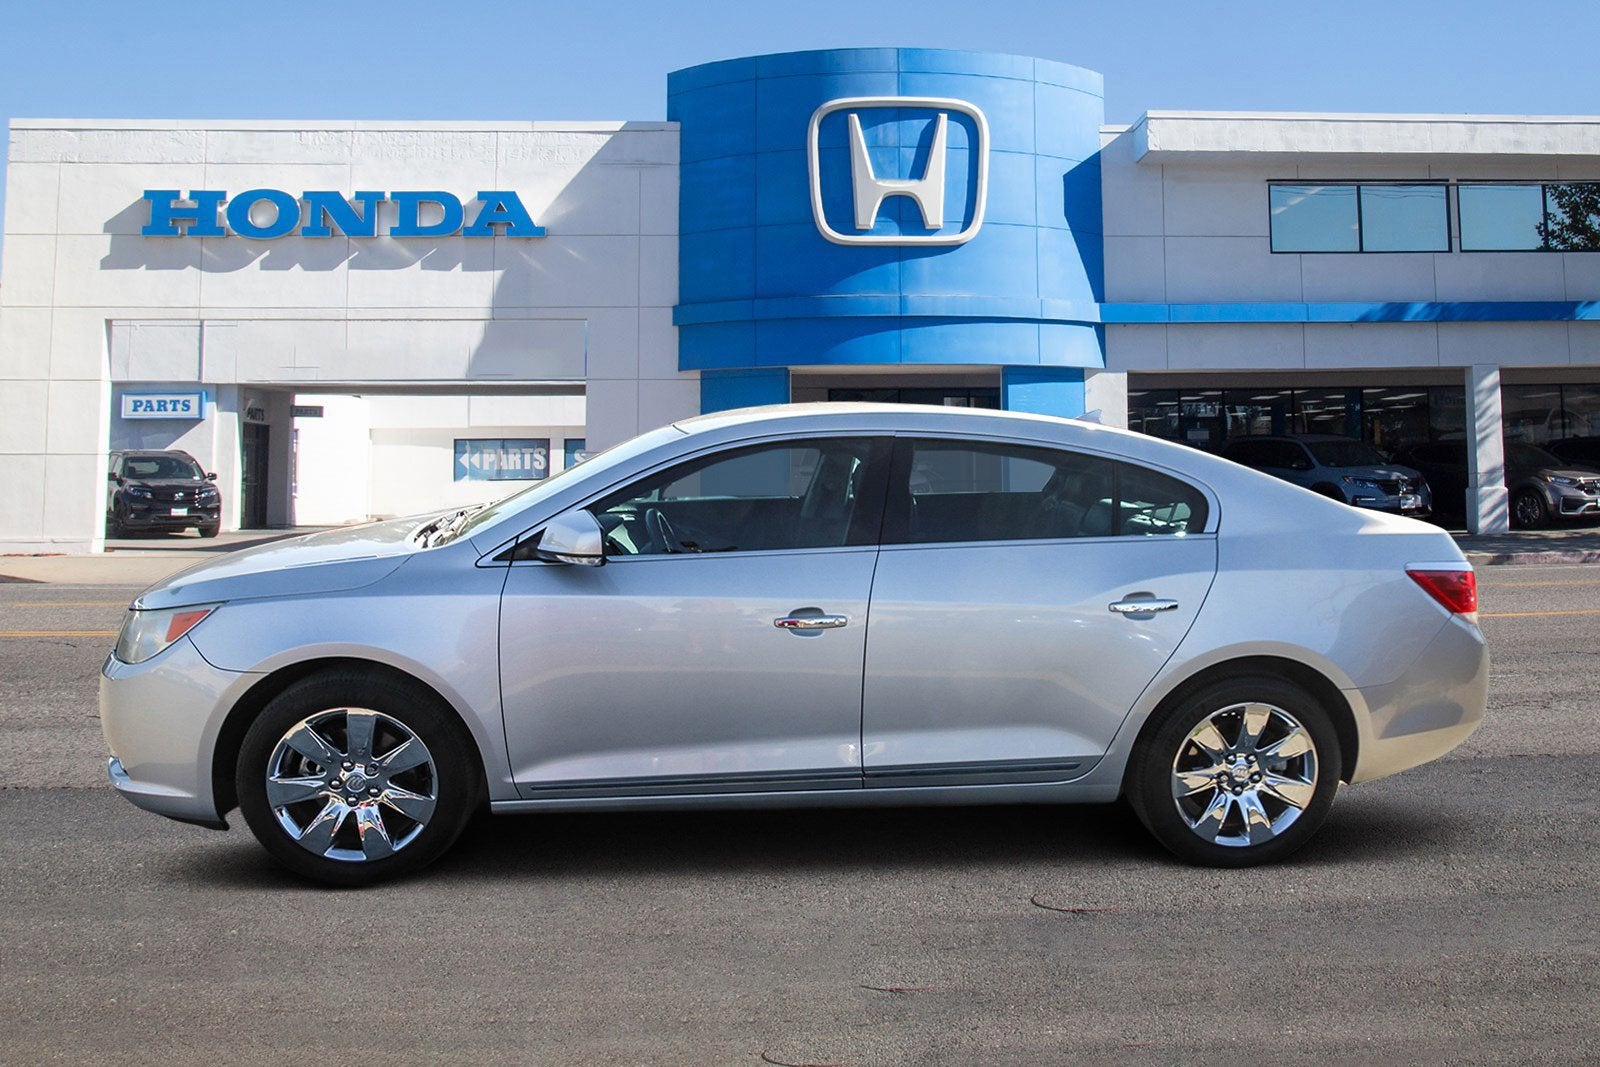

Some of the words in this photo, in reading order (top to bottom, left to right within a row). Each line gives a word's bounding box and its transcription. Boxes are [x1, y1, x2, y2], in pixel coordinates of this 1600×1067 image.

[142, 189, 547, 239] HONDA
[132, 400, 191, 412] PARTS
[244, 407, 265, 421] ARTS
[482, 447, 547, 470] PARTS
